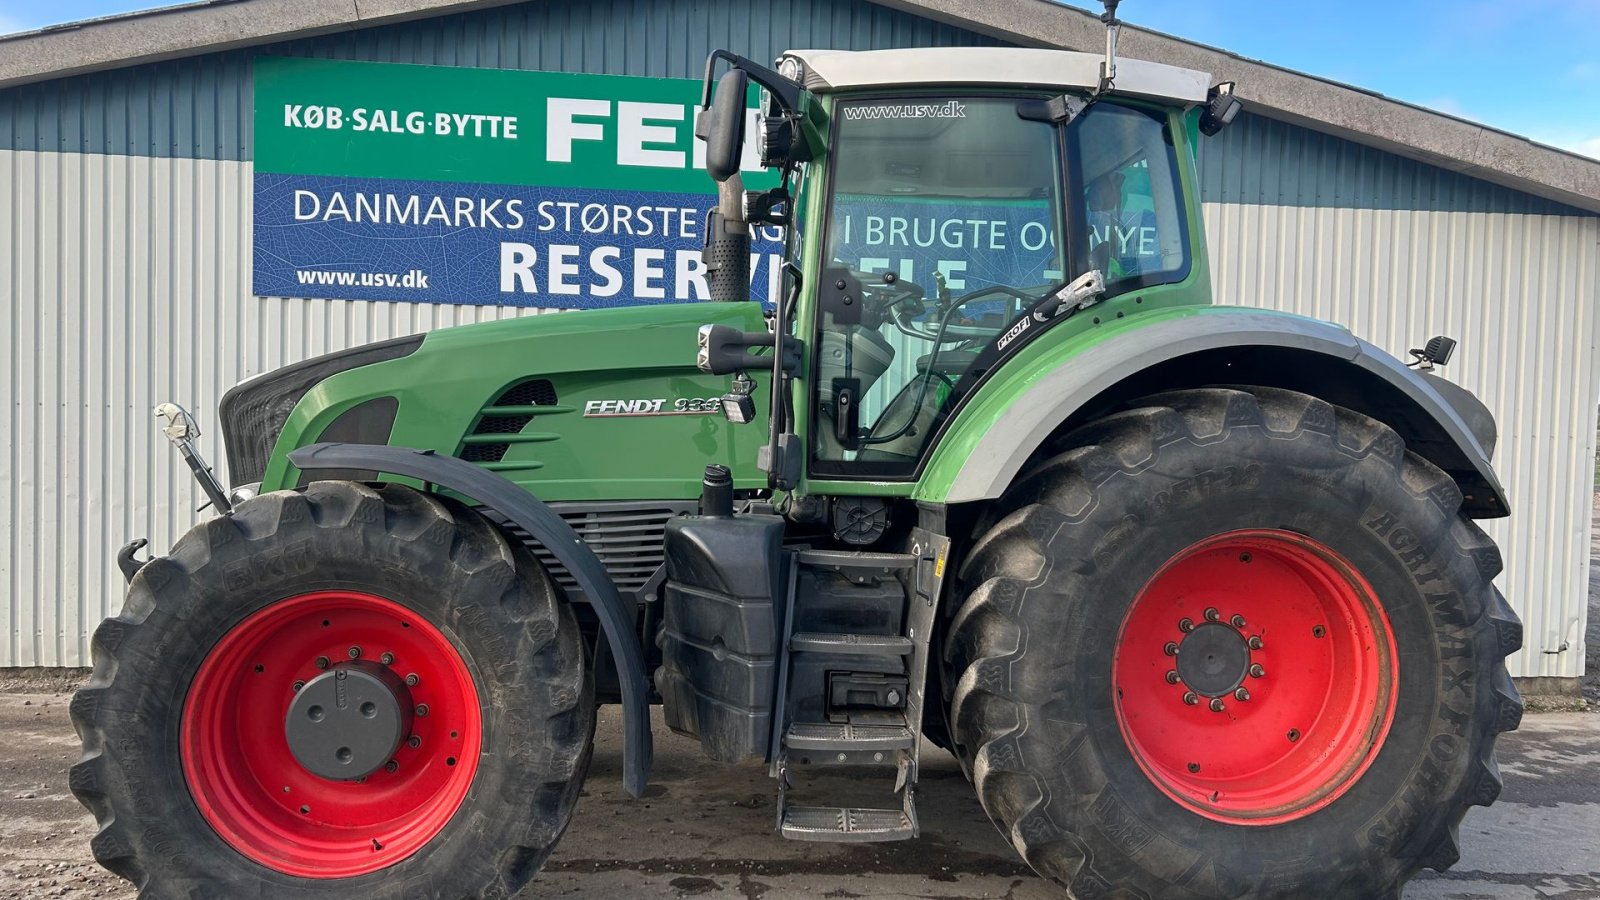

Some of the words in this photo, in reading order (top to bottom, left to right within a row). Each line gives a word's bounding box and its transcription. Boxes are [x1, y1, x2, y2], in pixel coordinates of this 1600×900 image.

[844, 101, 966, 120] www.usv.dk
[294, 189, 525, 230] DANMARKS
[538, 199, 698, 238] STØRSTE
[844, 215, 852, 245] I
[865, 216, 1007, 250] BRUGTE
[296, 269, 430, 289] www.usv.dk
[999, 316, 1030, 349] PROFI
[584, 398, 667, 415] FENDT
